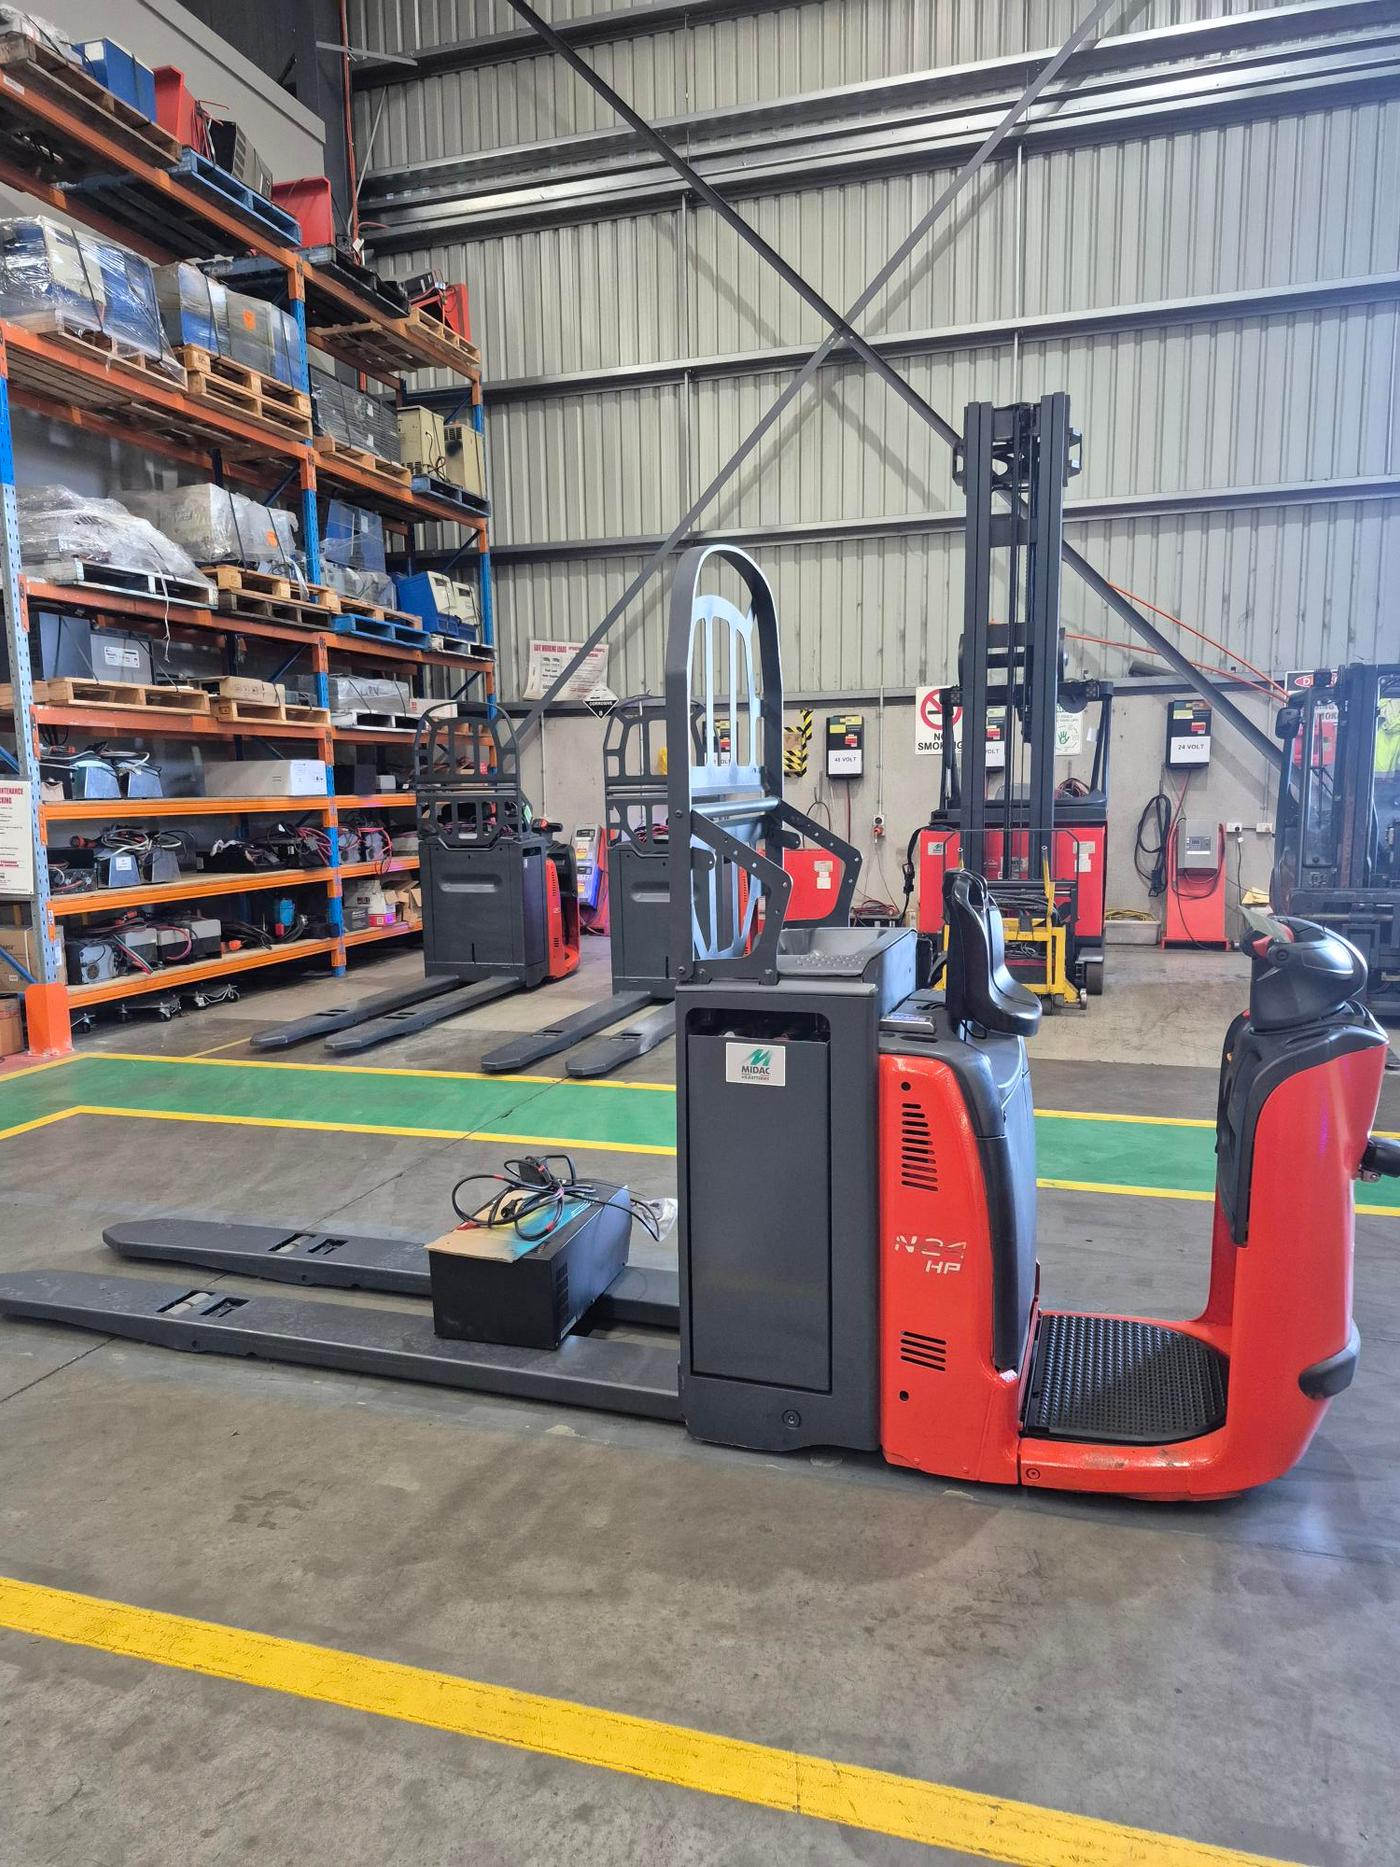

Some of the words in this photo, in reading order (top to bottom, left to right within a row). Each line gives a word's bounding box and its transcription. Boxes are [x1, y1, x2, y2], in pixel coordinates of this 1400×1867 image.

[917, 741, 963, 752] SMOG
[741, 1065, 771, 1075] MIDAC
[925, 1260, 961, 1275] HP
